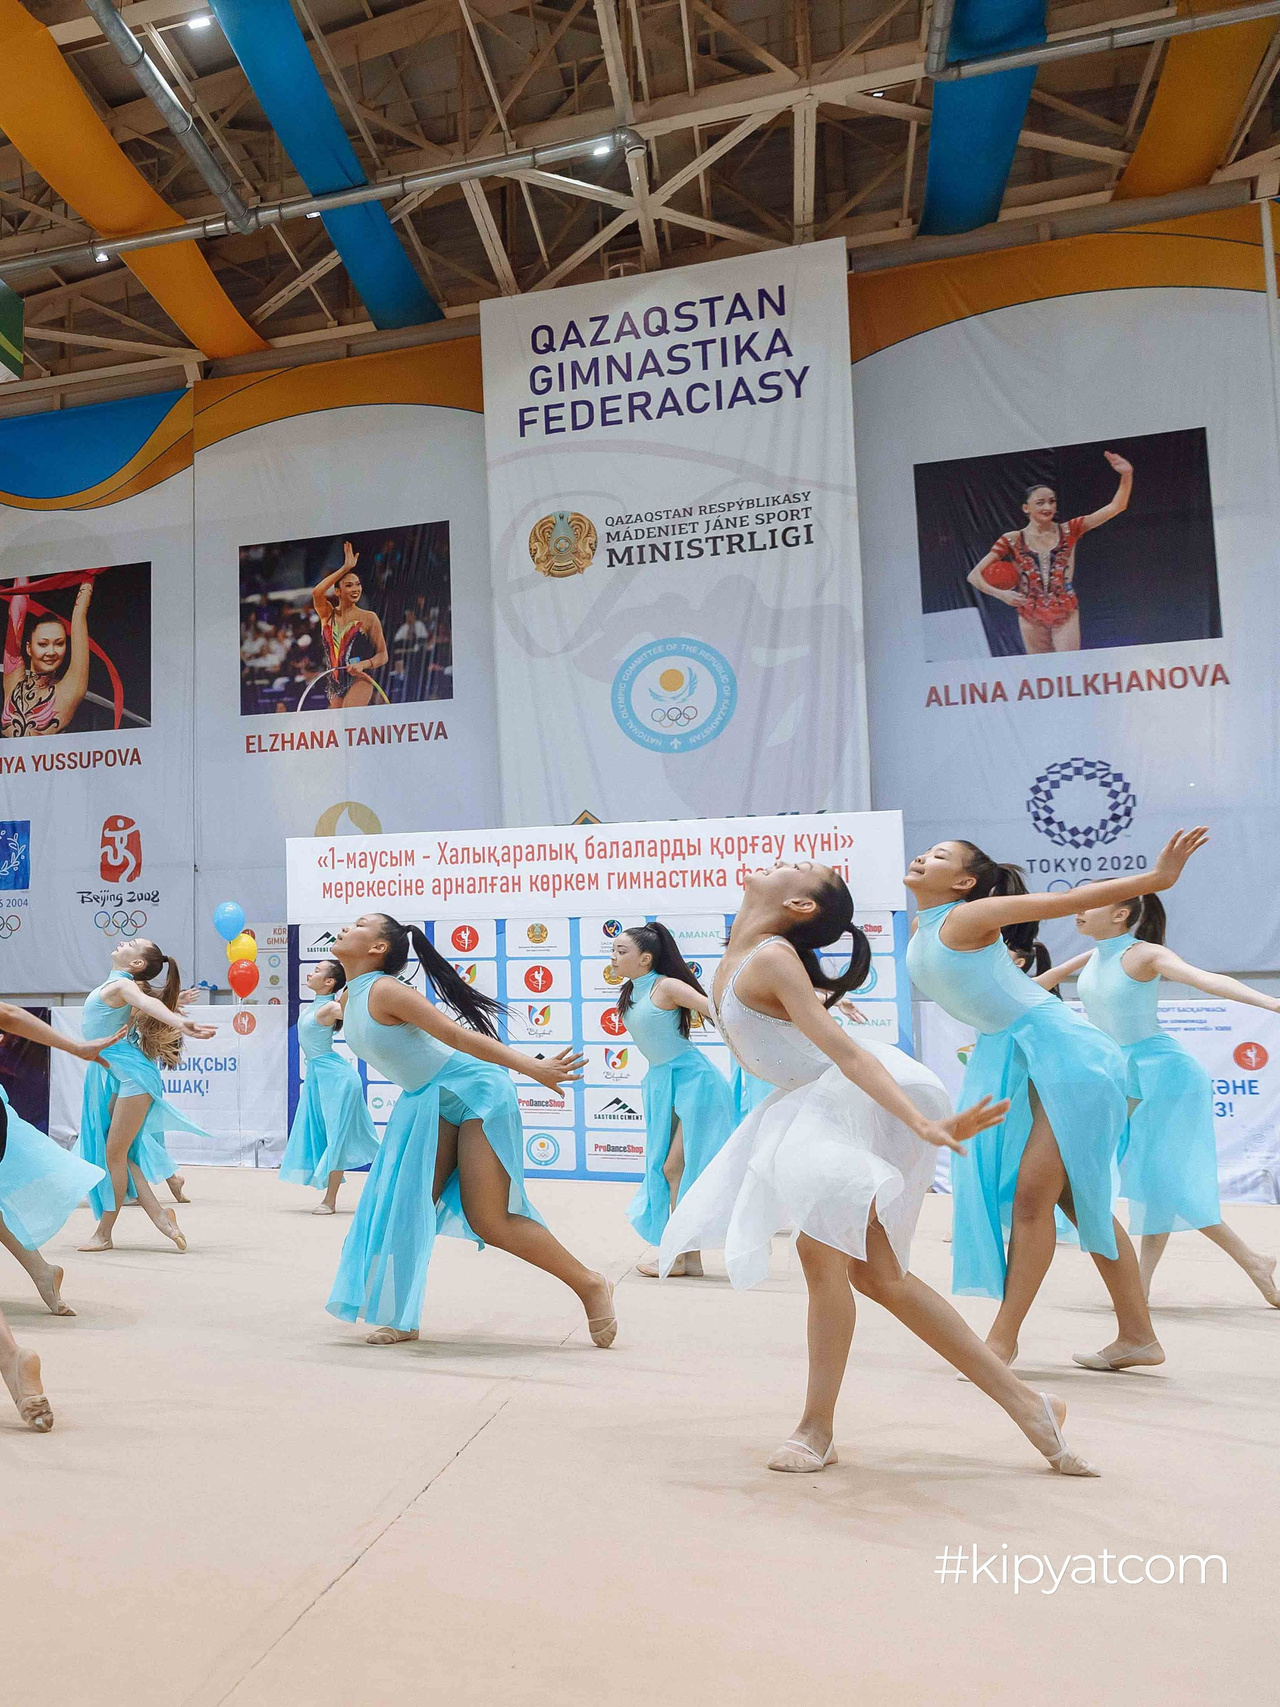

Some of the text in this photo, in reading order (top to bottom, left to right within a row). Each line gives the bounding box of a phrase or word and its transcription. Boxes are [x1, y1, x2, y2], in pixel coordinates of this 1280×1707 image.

[529, 284, 787, 355] QAZAQSTAN
[528, 327, 794, 396] GIMNASTIKA
[518, 365, 812, 438] FEDERACIASY
[605, 490, 812, 527] QAZAQSTAN RESPÝBLIKASY
[605, 506, 812, 543] MÁDENIET JÁNE SPORT
[606, 523, 814, 568] MINISTRLIGI
[925, 663, 1230, 707] ALINA ADILKHANOVA
[245, 721, 449, 754] ELZHANA TANIYEVA
[31, 746, 142, 773] YUSSUPOVA
[317, 846, 416, 874] «1-маусым
[437, 840, 579, 869] Халықаралық
[585, 835, 702, 864] балаларды
[710, 833, 785, 862] қорғау
[794, 826, 855, 859] күні»
[1026, 854, 1148, 874] TOKYO 2020
[6, 898, 29, 908] 2004
[76, 890, 160, 907] Beijing 2008
[322, 873, 425, 904] мерекесіне
[431, 873, 522, 901] арналған
[529, 870, 600, 898] көркем
[607, 866, 728, 892] гимнастика
[678, 930, 721, 939] AMANAT
[1211, 1079, 1260, 1095] ӘНЕ
